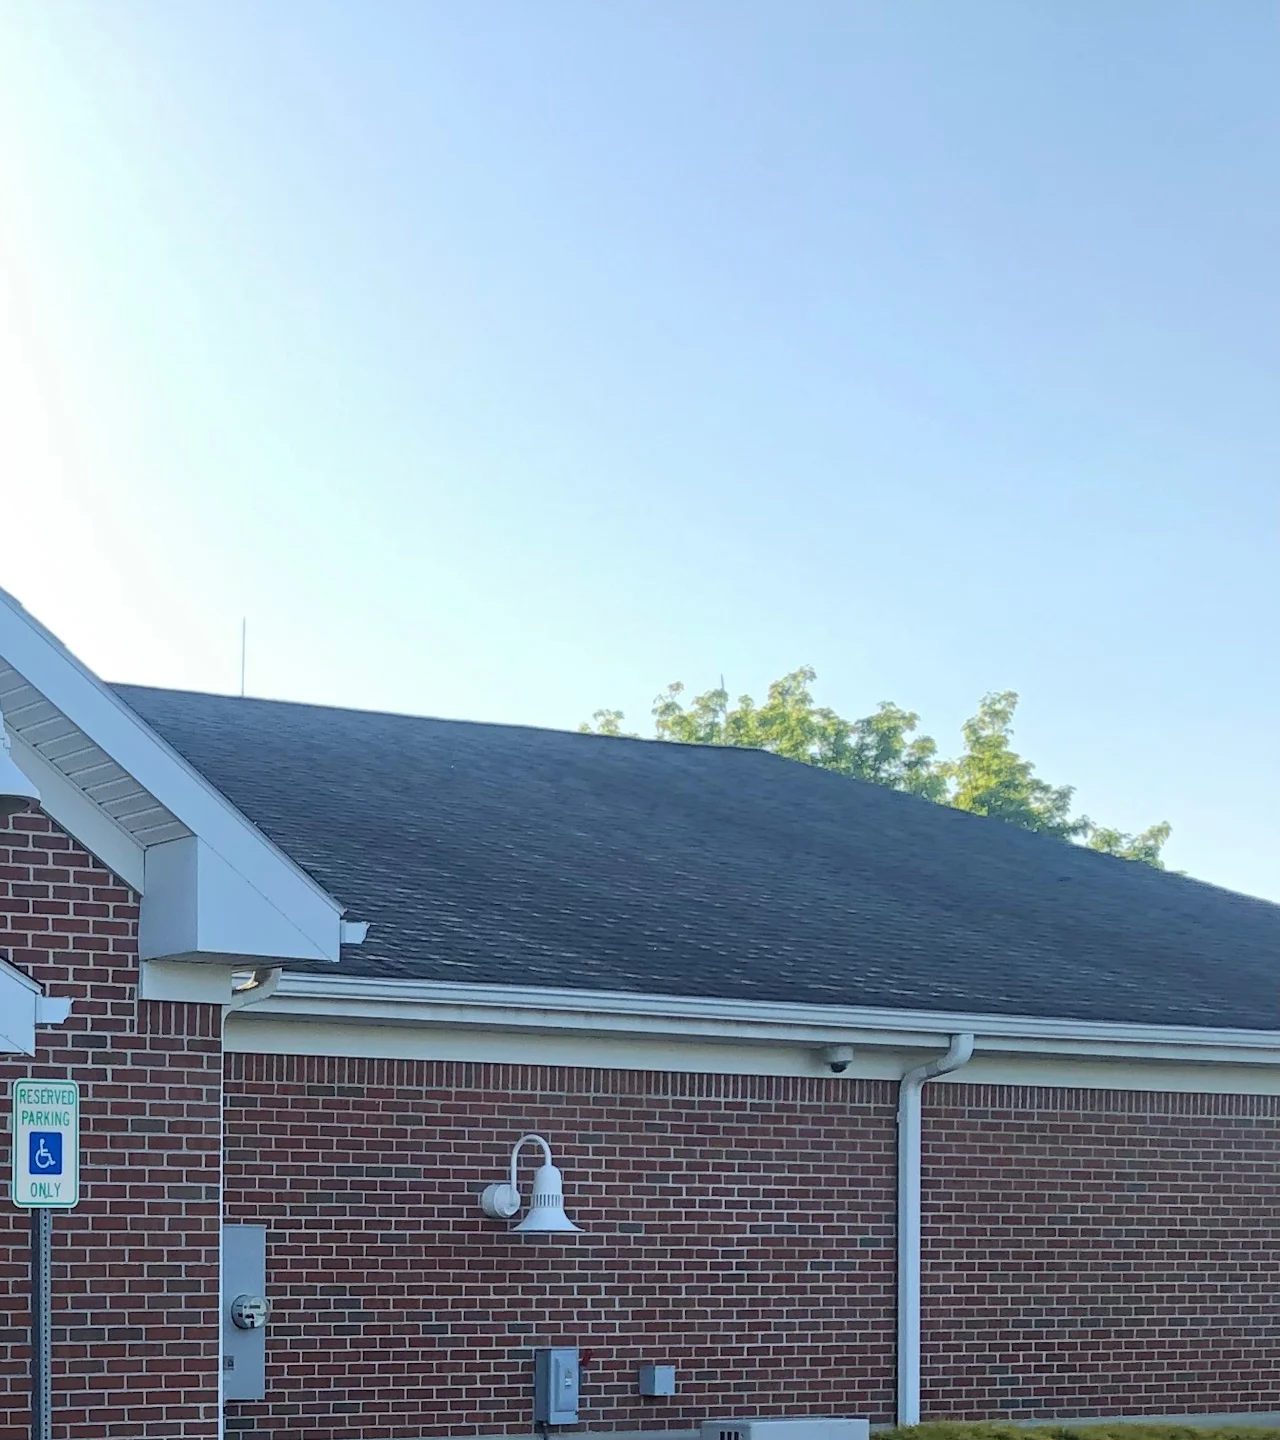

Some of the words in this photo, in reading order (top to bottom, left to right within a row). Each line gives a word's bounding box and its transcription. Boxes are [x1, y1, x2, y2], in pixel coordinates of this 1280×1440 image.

[19, 1089, 74, 1105] RESERVED
[22, 1110, 70, 1126] PARKING
[30, 1182, 61, 1198] ONLY
